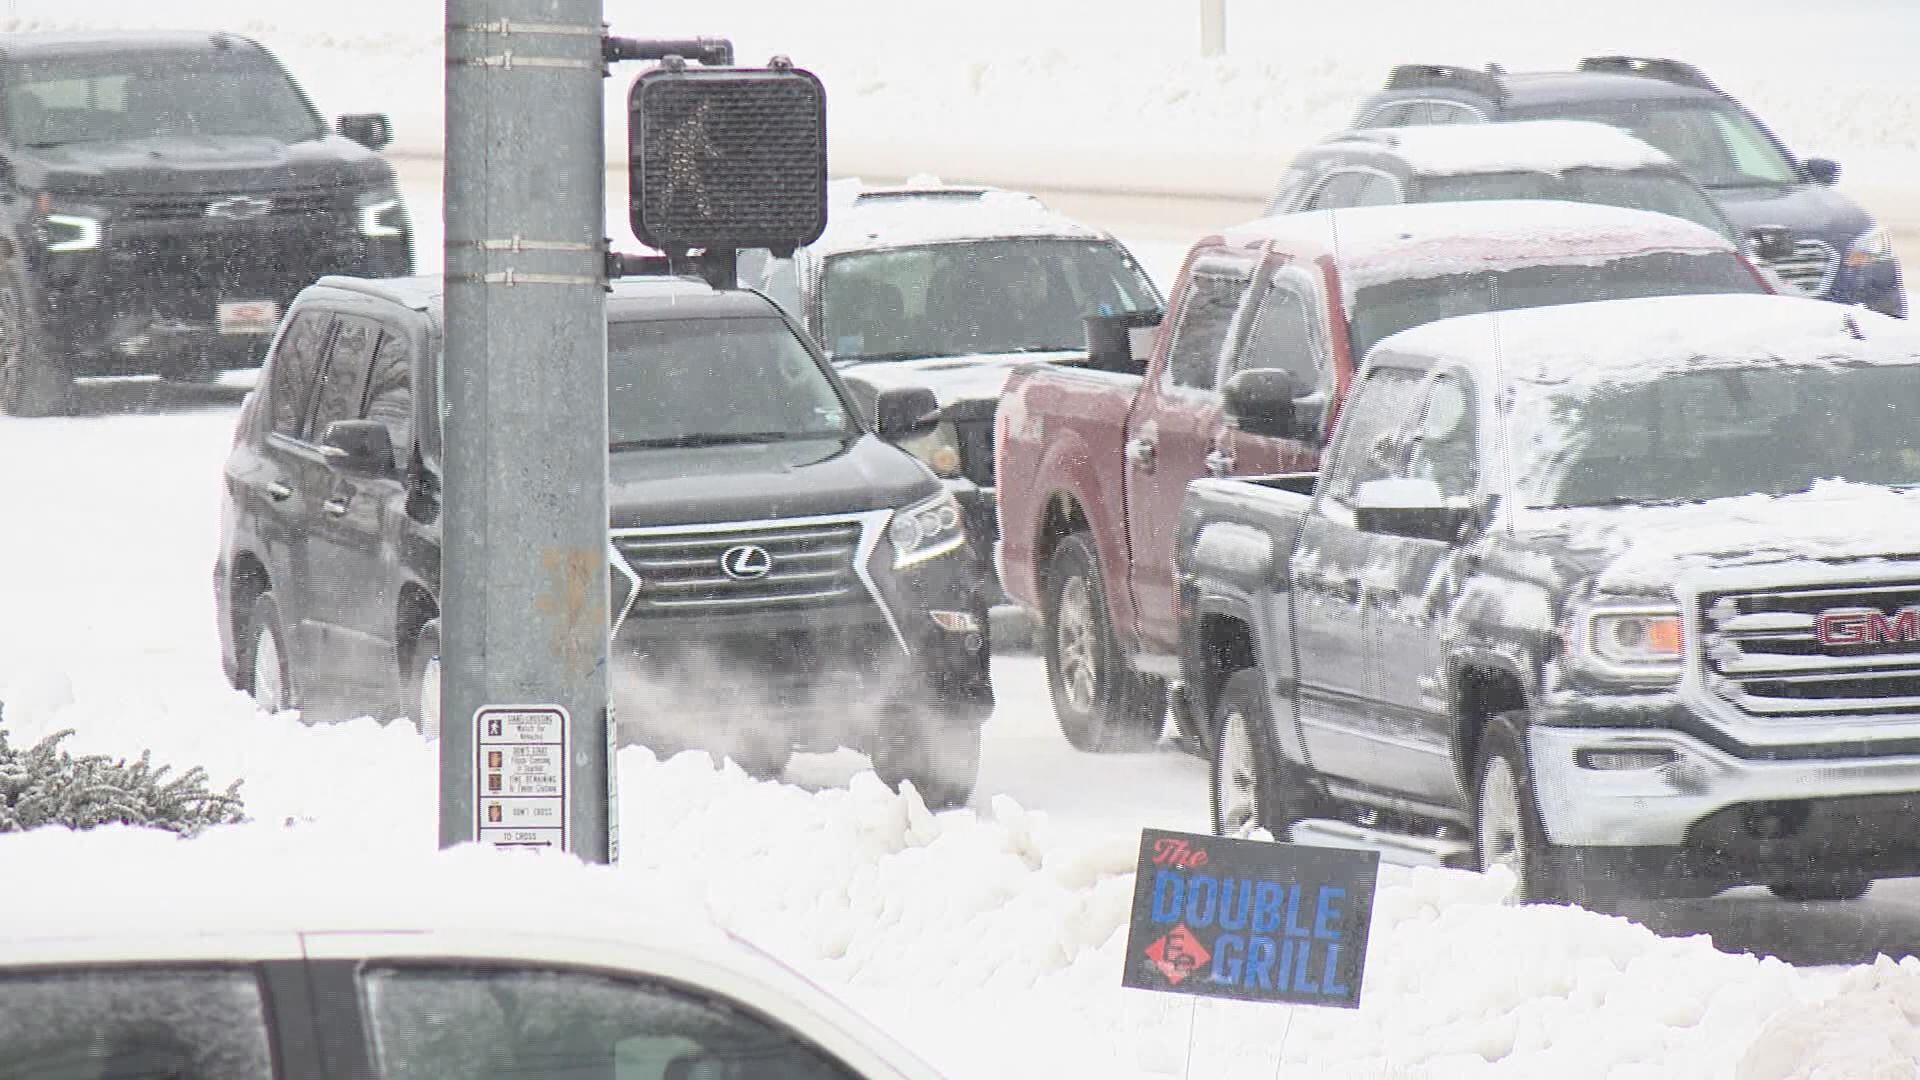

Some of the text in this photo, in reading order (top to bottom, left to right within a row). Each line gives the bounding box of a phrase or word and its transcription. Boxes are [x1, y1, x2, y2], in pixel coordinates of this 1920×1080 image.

[504, 832, 537, 841] TO CROSS
[1153, 839, 1208, 867] The
[1152, 870, 1346, 939] DOUBLE
[1212, 933, 1349, 994] GRILL
